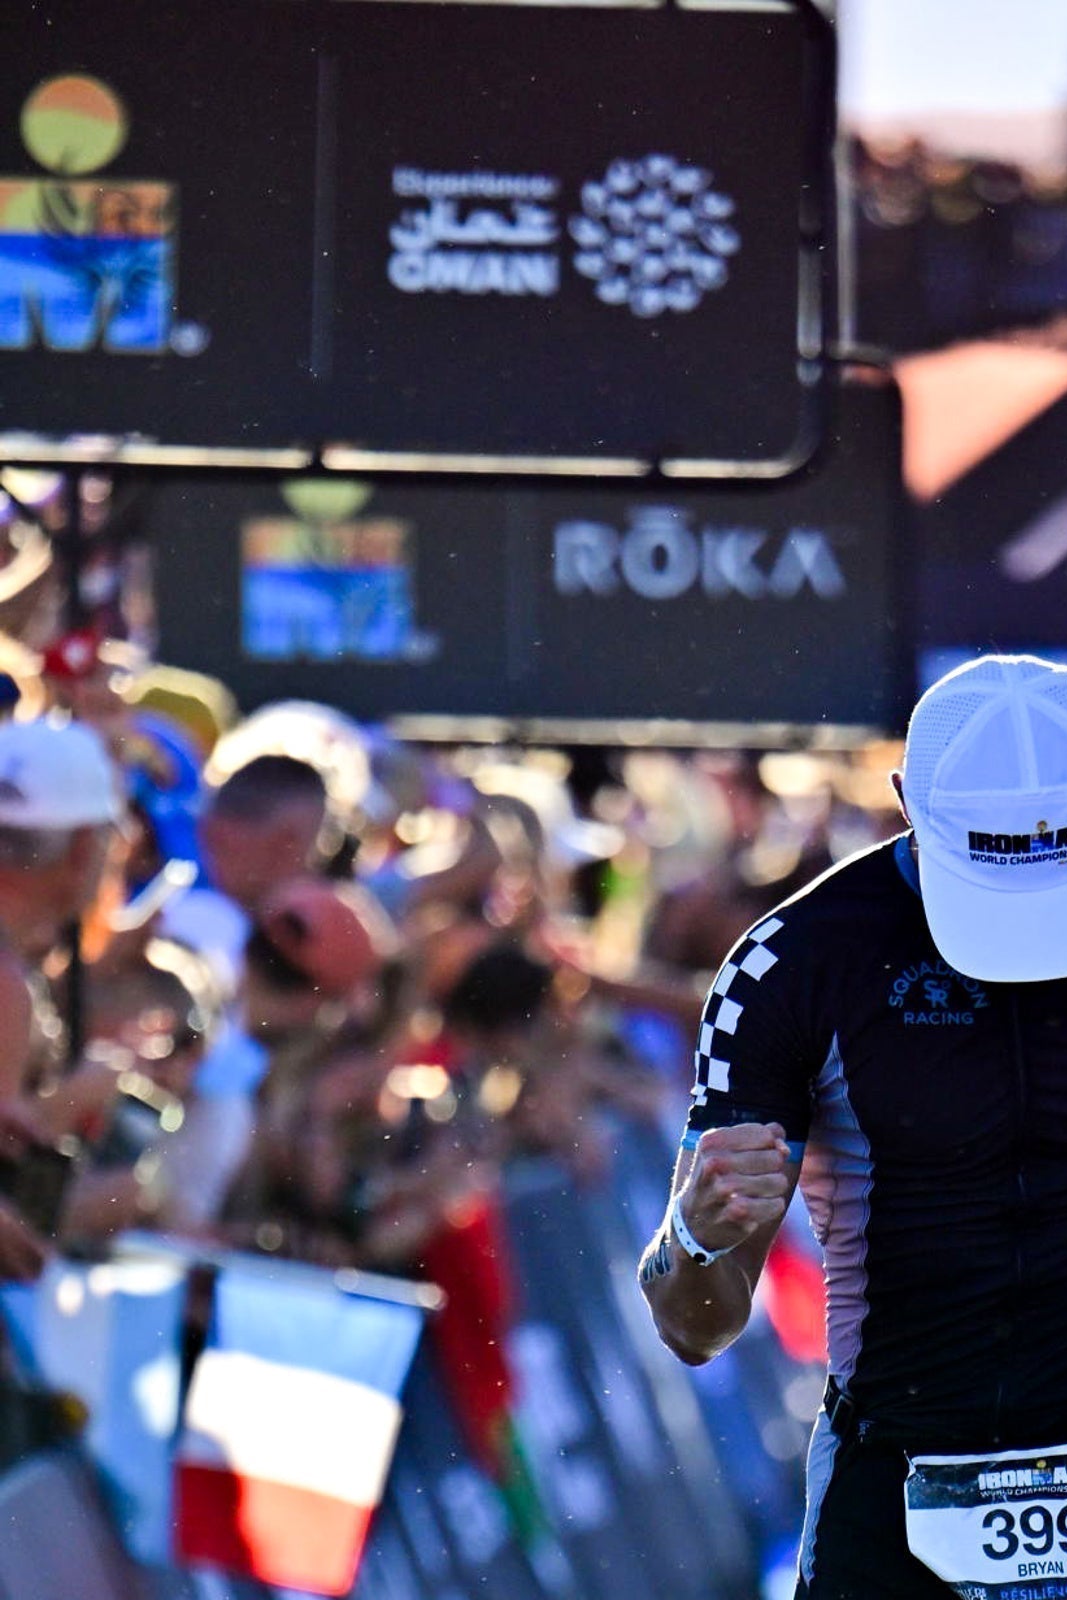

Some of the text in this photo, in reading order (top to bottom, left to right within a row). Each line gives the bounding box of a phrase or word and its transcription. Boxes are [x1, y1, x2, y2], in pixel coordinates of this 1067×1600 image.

[389, 253, 559, 295] OMAN
[969, 851, 1007, 866] WORLD
[903, 1011, 975, 1026] RACING
[1017, 1561, 1065, 1577] BRYAN
